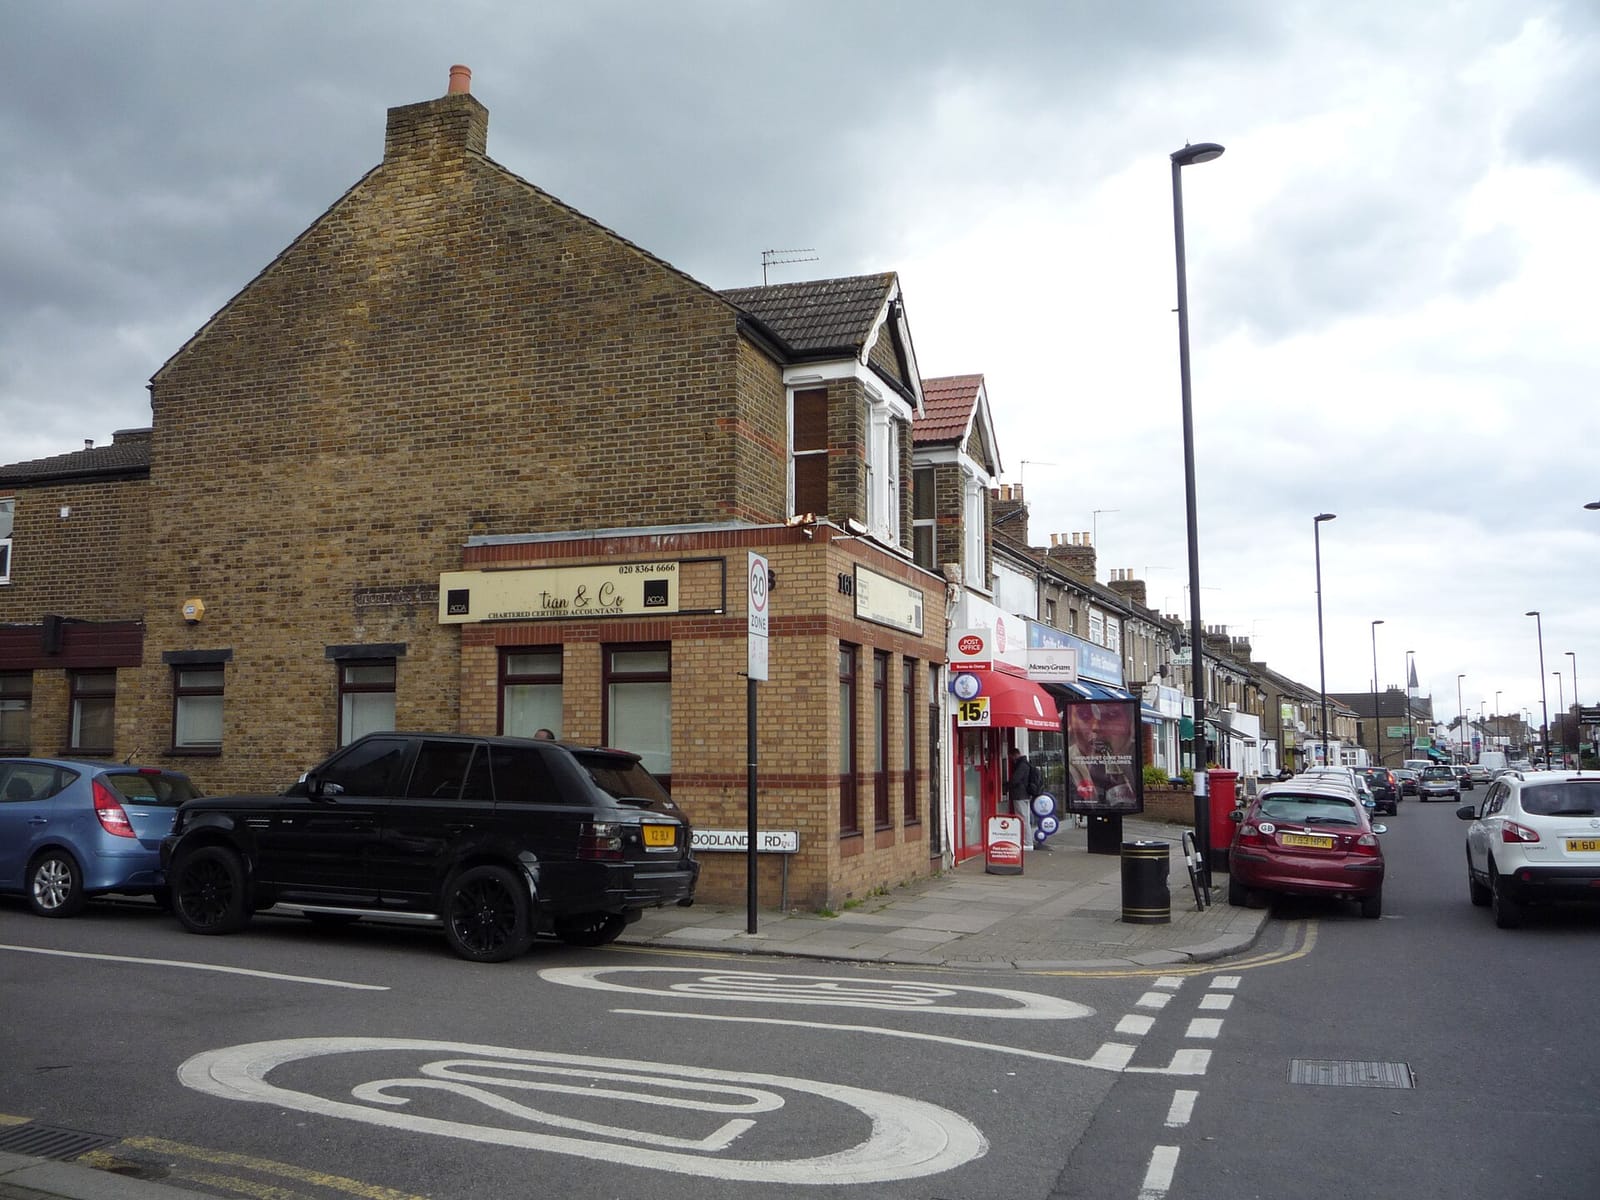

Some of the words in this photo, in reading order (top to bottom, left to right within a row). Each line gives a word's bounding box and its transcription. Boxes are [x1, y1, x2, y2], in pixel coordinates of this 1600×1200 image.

[618, 565, 633, 575] 020
[635, 564, 653, 574] 8364
[656, 563, 675, 573] 6666
[752, 573, 765, 597] 20
[539, 590, 569, 610] tian
[574, 584, 592, 607] &
[598, 581, 625, 606] Co
[488, 610, 531, 619] CHARTERED
[532, 609, 569, 617] CERTIFIED
[571, 607, 624, 616] ACCOUNTANTS
[751, 614, 766, 630] ZONE
[1029, 663, 1071, 671] MoneyGram
[1260, 824, 1273, 832] GB
[691, 834, 748, 847] OODLAND
[764, 835, 781, 847] RD
[1582, 841, 1596, 850] 60
[351, 1057, 786, 1153] 20
